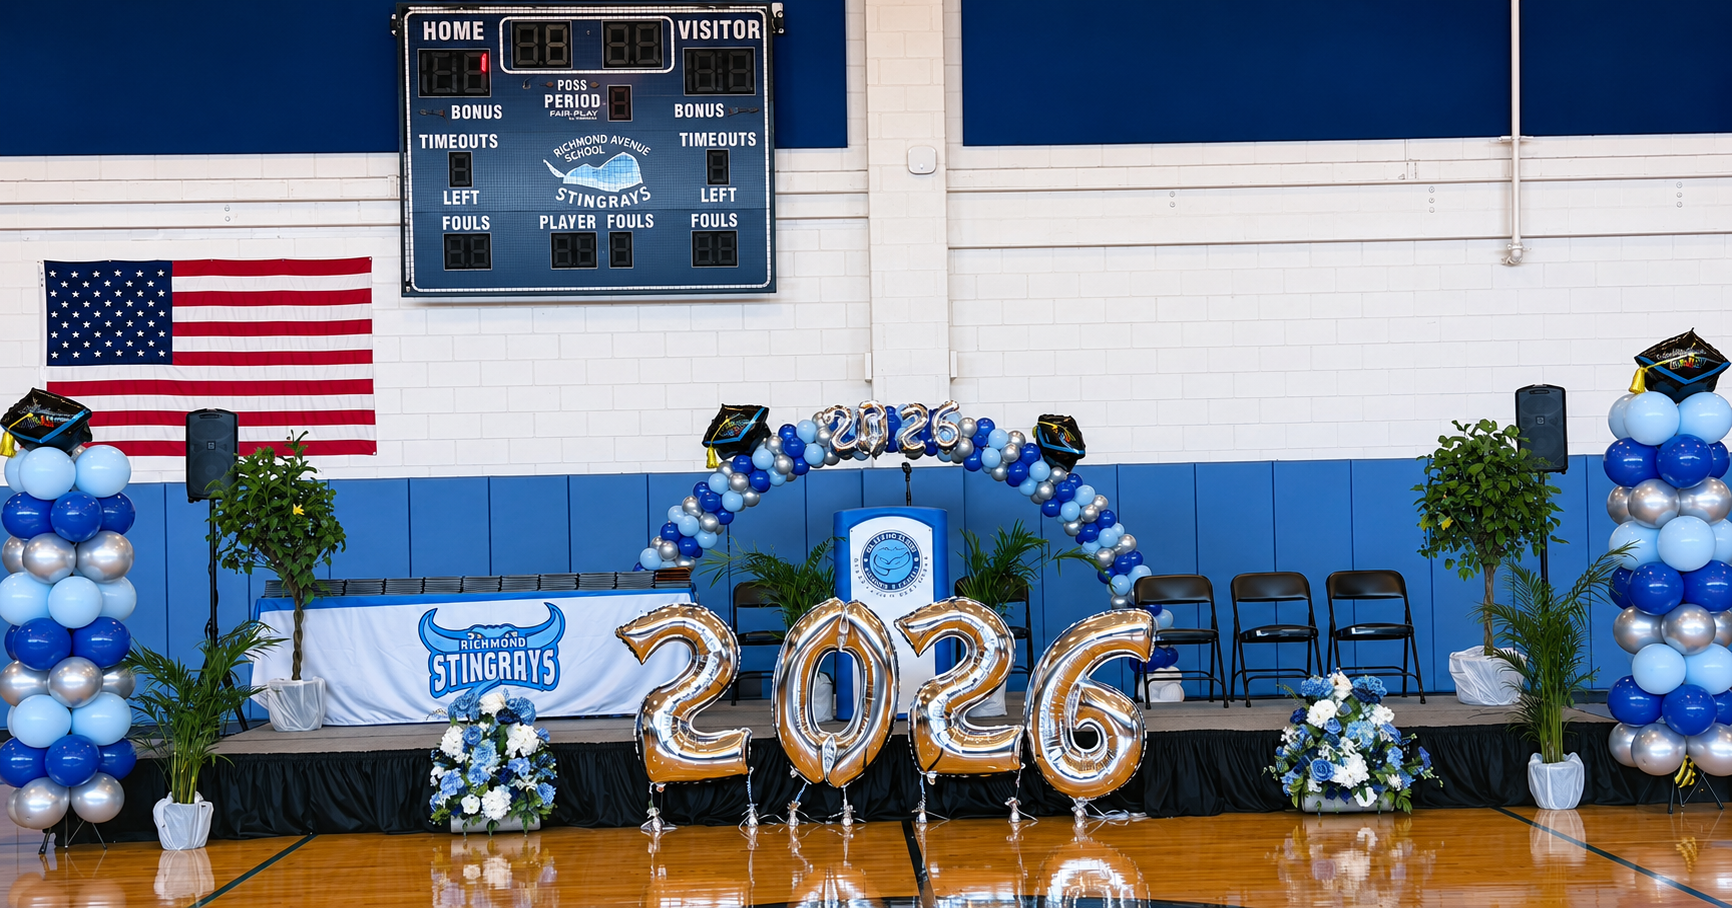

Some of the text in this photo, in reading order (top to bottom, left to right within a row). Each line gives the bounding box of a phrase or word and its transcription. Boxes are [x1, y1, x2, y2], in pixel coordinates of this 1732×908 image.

[423, 21, 484, 40] HOME
[677, 20, 761, 40] VISITOR
[557, 79, 587, 91] POSS
[544, 93, 601, 109] PERIOD
[451, 104, 503, 120] BONUS
[549, 109, 598, 117] FAIR-PLAY
[674, 103, 725, 119] BONUS
[418, 134, 499, 149] TIMEOUTS
[553, 134, 652, 158] RICHMOND AVENUE
[679, 132, 757, 147] TIMEOUTS
[564, 145, 605, 163] SCHOOL
[443, 190, 480, 205] LEFT
[555, 186, 651, 208] STINGRAYS
[701, 188, 737, 203] LEFT
[442, 215, 491, 231] FOULS
[539, 214, 655, 230] PLAYER FOULS
[691, 213, 738, 228] FOULS
[822, 399, 961, 459] 2026
[461, 637, 526, 650] RICHMOND
[433, 649, 556, 692] STINGRAYS
[615, 596, 1156, 799] 2026
